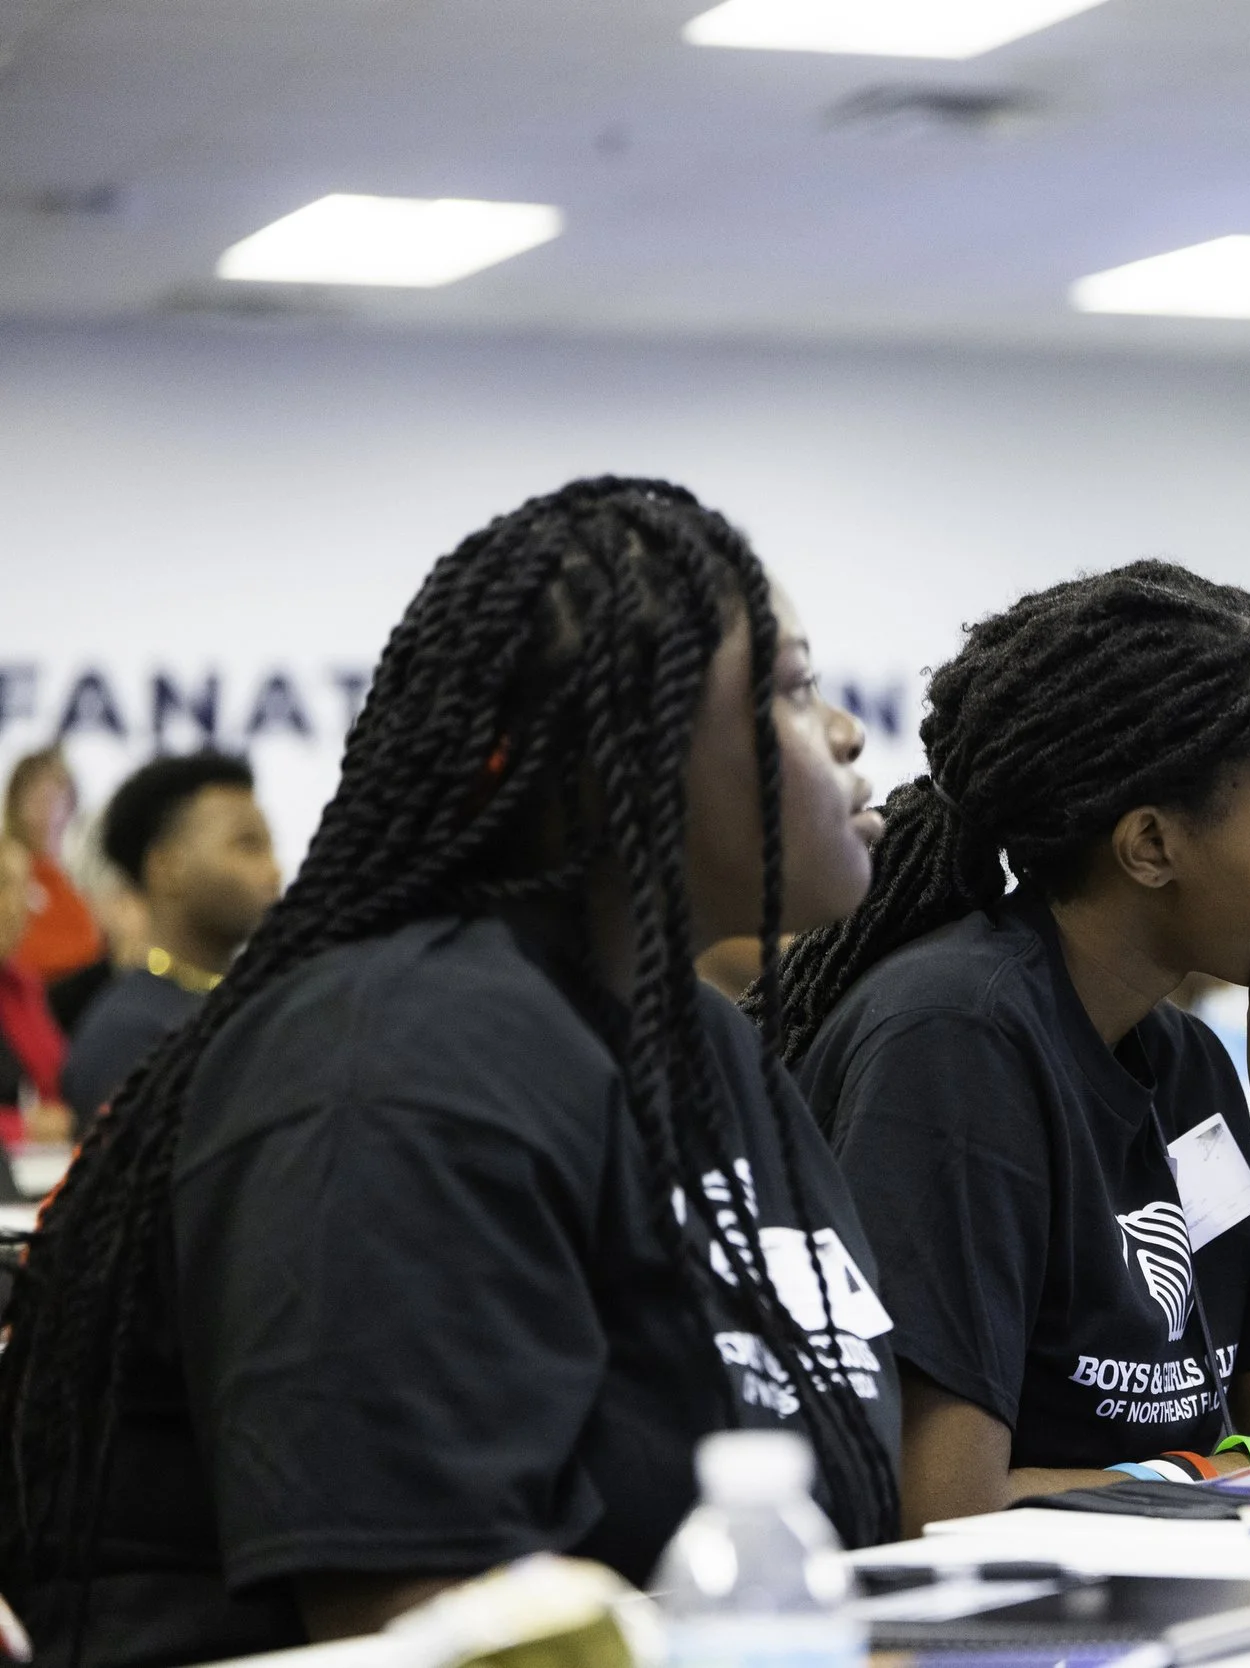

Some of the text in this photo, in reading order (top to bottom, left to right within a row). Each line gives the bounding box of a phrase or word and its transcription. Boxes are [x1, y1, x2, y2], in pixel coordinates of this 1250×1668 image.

[1068, 1355, 1151, 1394] BOYS
[1150, 1363, 1163, 1395] &
[1163, 1357, 1205, 1392] GIRLS
[1095, 1398, 1127, 1420] OF
[1126, 1395, 1198, 1424] NORTHEAST
